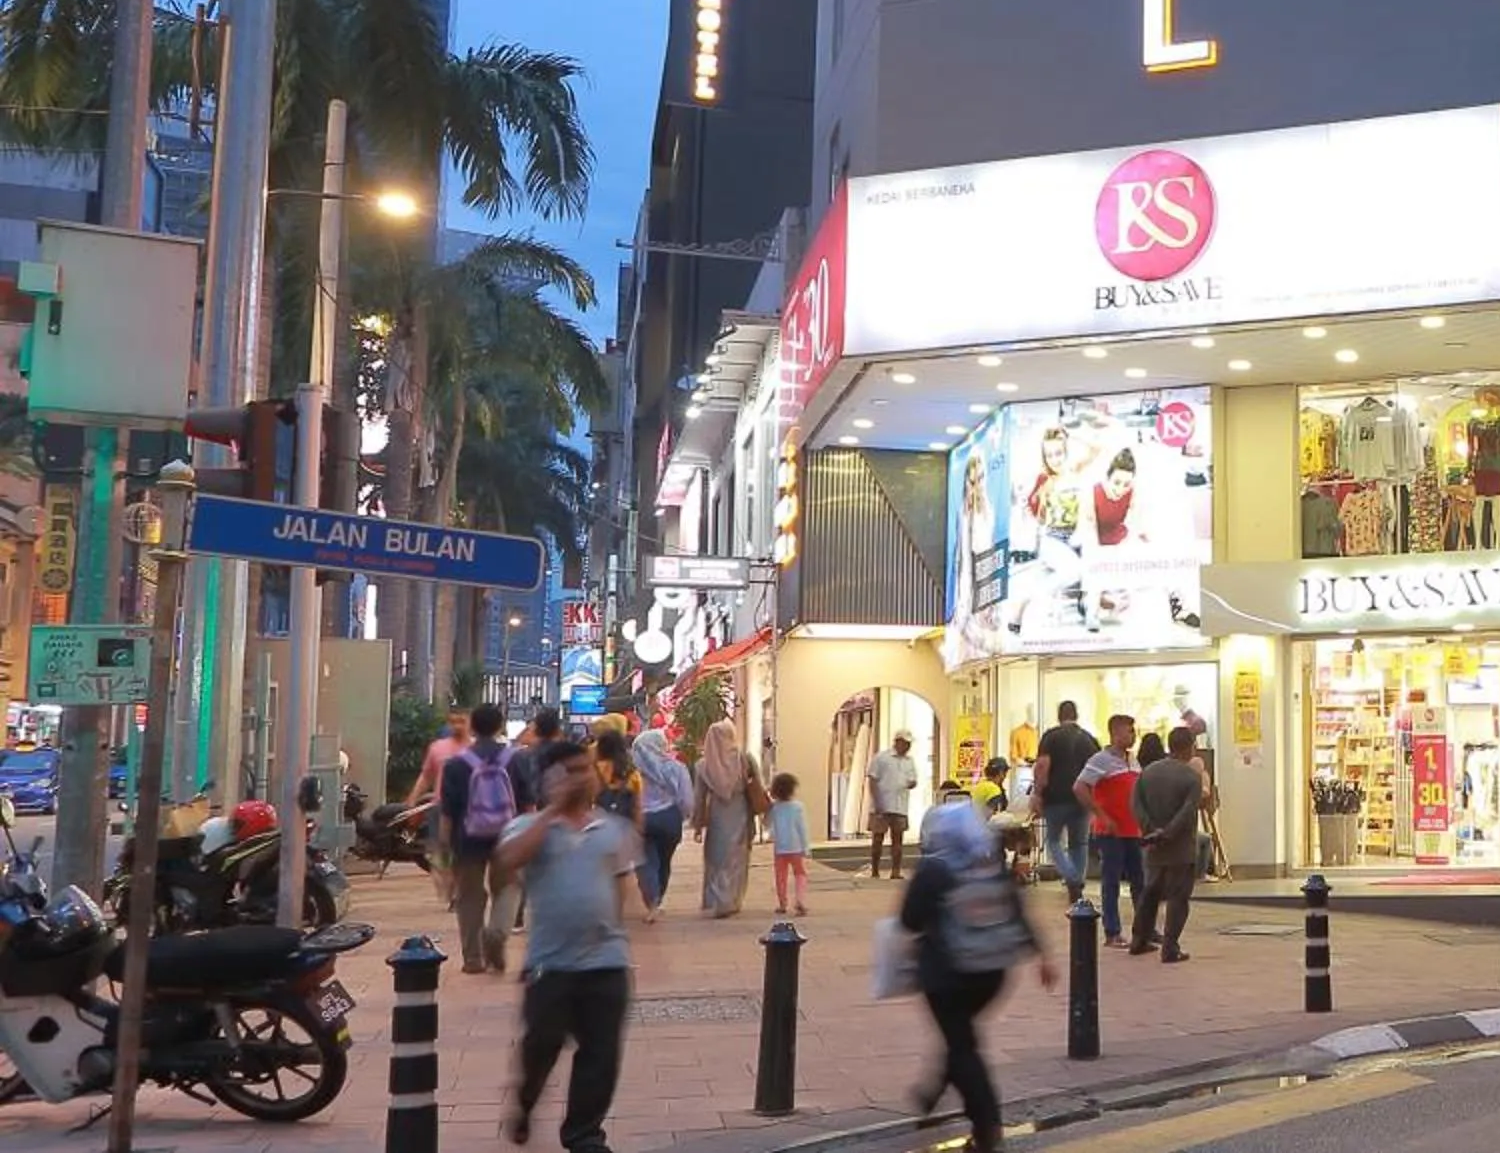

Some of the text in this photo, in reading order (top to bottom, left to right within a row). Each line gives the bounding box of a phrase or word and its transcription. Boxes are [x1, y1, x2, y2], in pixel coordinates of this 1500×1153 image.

[1095, 277, 1224, 310] BUY&SAVE
[273, 515, 367, 548] JALAN
[385, 529, 475, 561] BULAN
